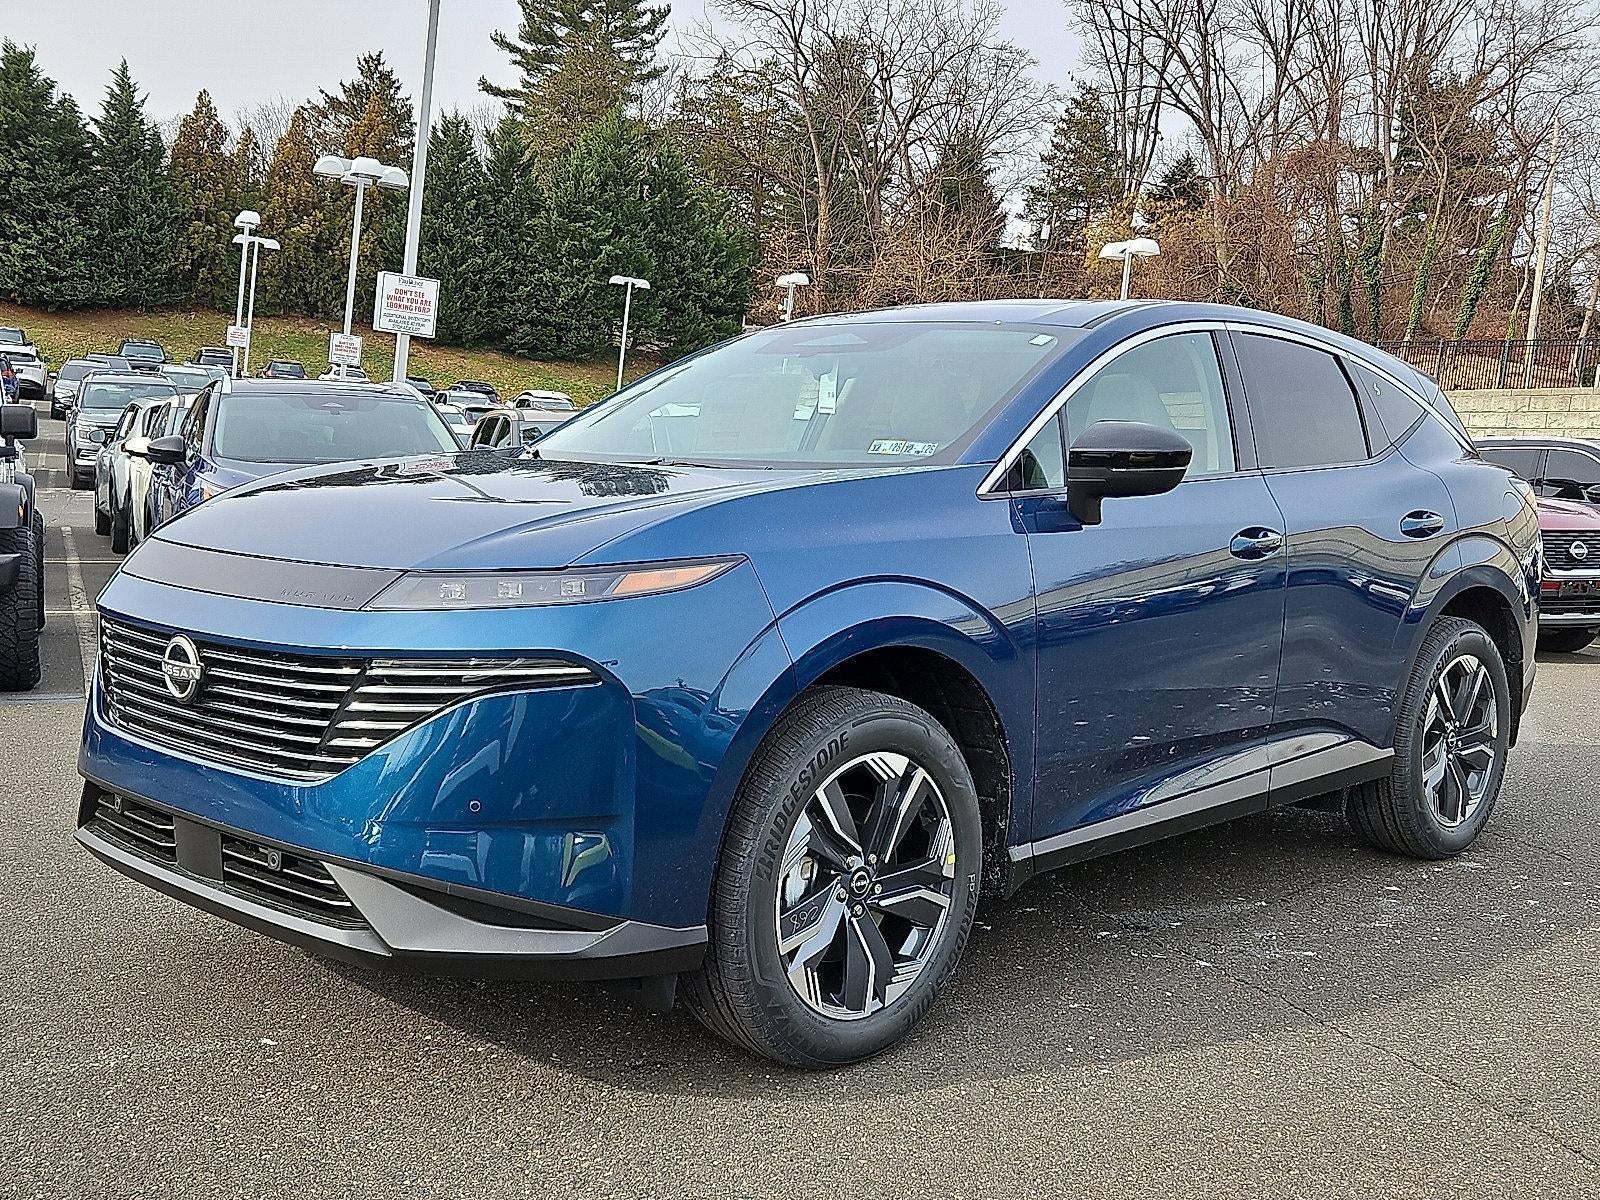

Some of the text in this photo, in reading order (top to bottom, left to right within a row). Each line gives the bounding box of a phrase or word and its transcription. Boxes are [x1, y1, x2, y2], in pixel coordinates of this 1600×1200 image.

[386, 294, 432, 307] WHAT YOU ARE
[386, 301, 414, 311] LOOKING
[163, 662, 201, 680] ISSAN
[755, 730, 850, 882] BRIDGESTONE
